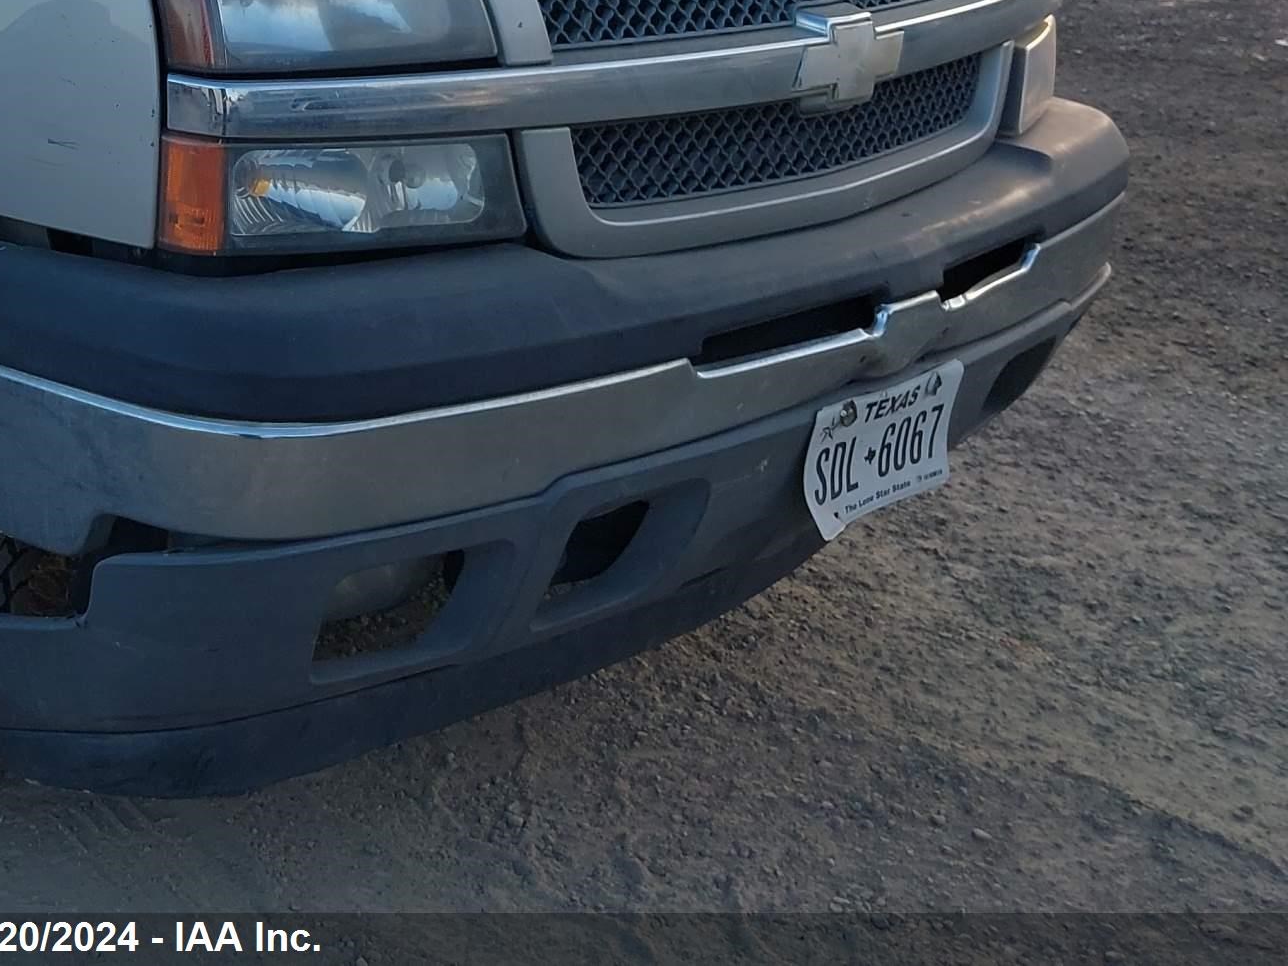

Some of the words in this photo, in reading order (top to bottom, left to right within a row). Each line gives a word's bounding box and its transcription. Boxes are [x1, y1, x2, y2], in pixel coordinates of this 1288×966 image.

[864, 385, 921, 423] TEXAS
[877, 404, 944, 477] 6067
[858, 495, 874, 507] Lone
[876, 488, 891, 499] Star
[892, 481, 911, 493] State
